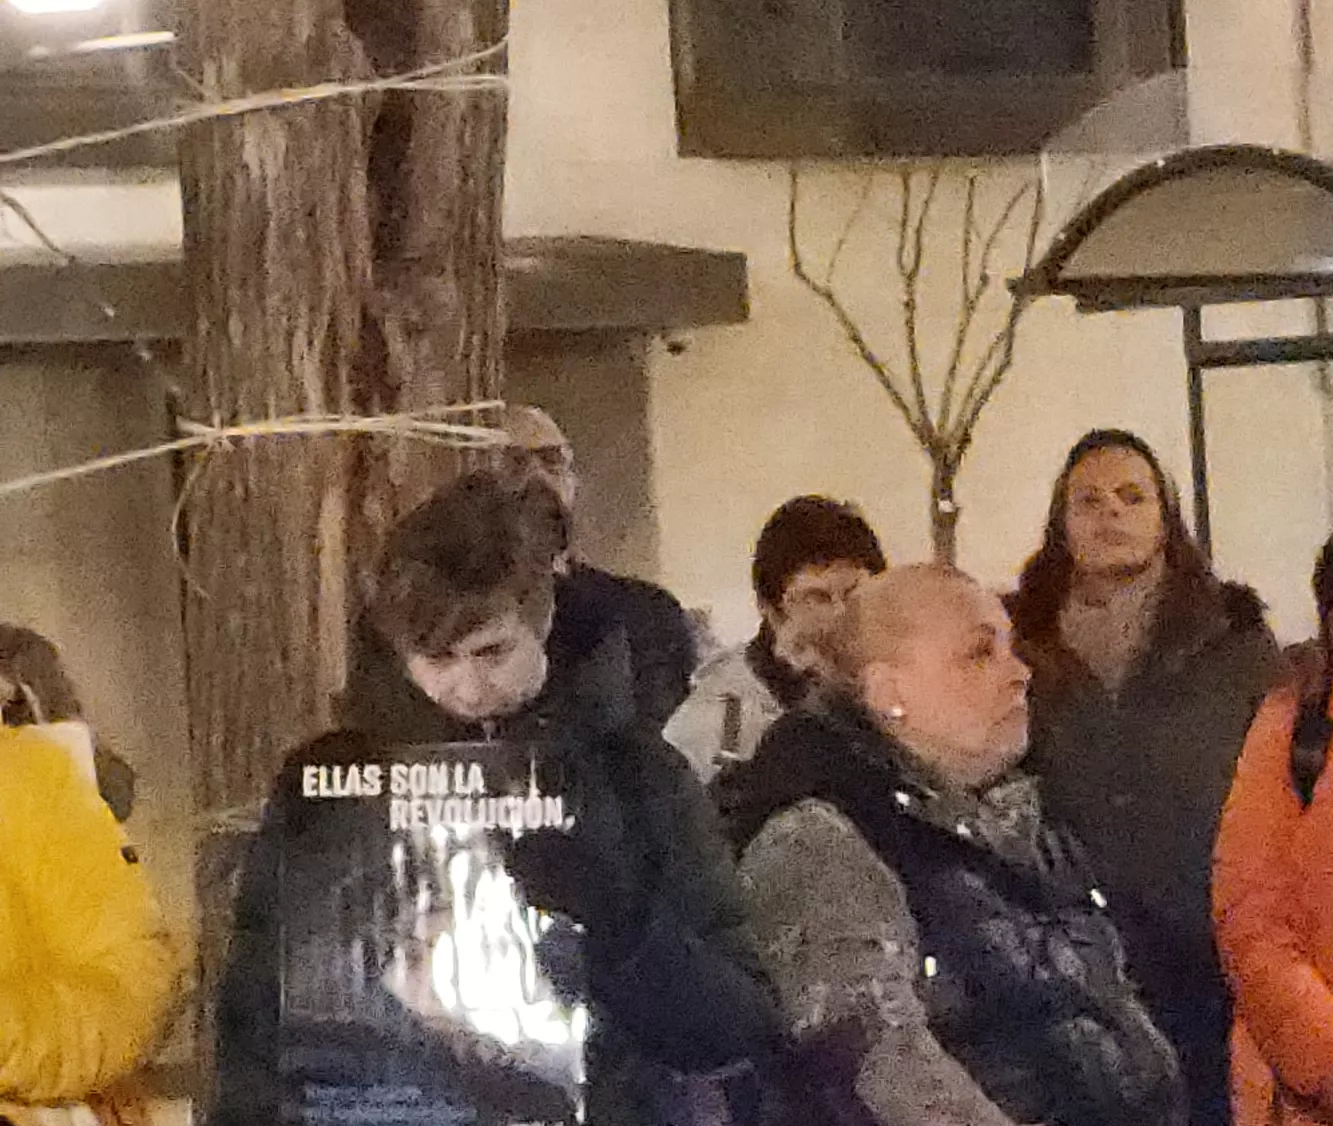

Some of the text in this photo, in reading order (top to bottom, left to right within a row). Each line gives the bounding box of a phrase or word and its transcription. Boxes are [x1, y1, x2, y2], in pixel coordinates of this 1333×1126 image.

[302, 763, 486, 798] ELLAS SON LA
